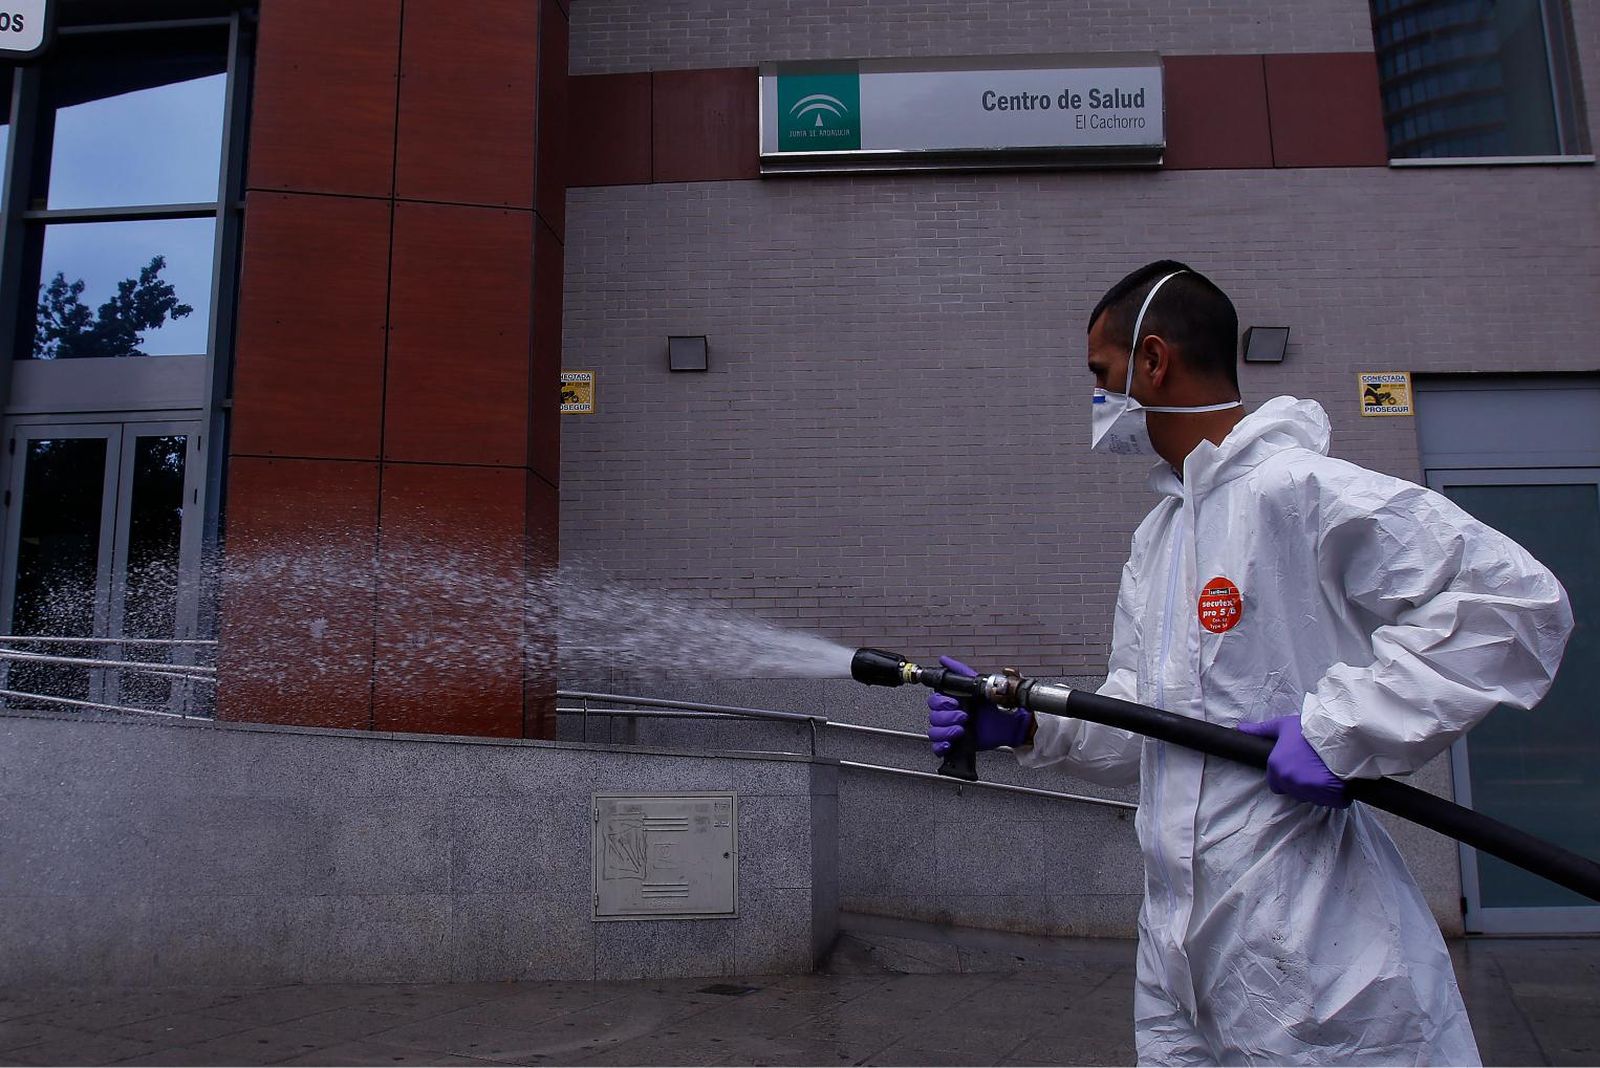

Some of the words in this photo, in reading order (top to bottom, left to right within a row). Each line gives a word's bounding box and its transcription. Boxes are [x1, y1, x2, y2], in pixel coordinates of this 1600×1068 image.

[981, 90, 1051, 111] Centro
[1057, 89, 1082, 109] de
[1088, 88, 1145, 109] Salud
[1075, 114, 1086, 129] El
[1089, 114, 1146, 129] Cachorro
[1203, 610, 1217, 618] pro
